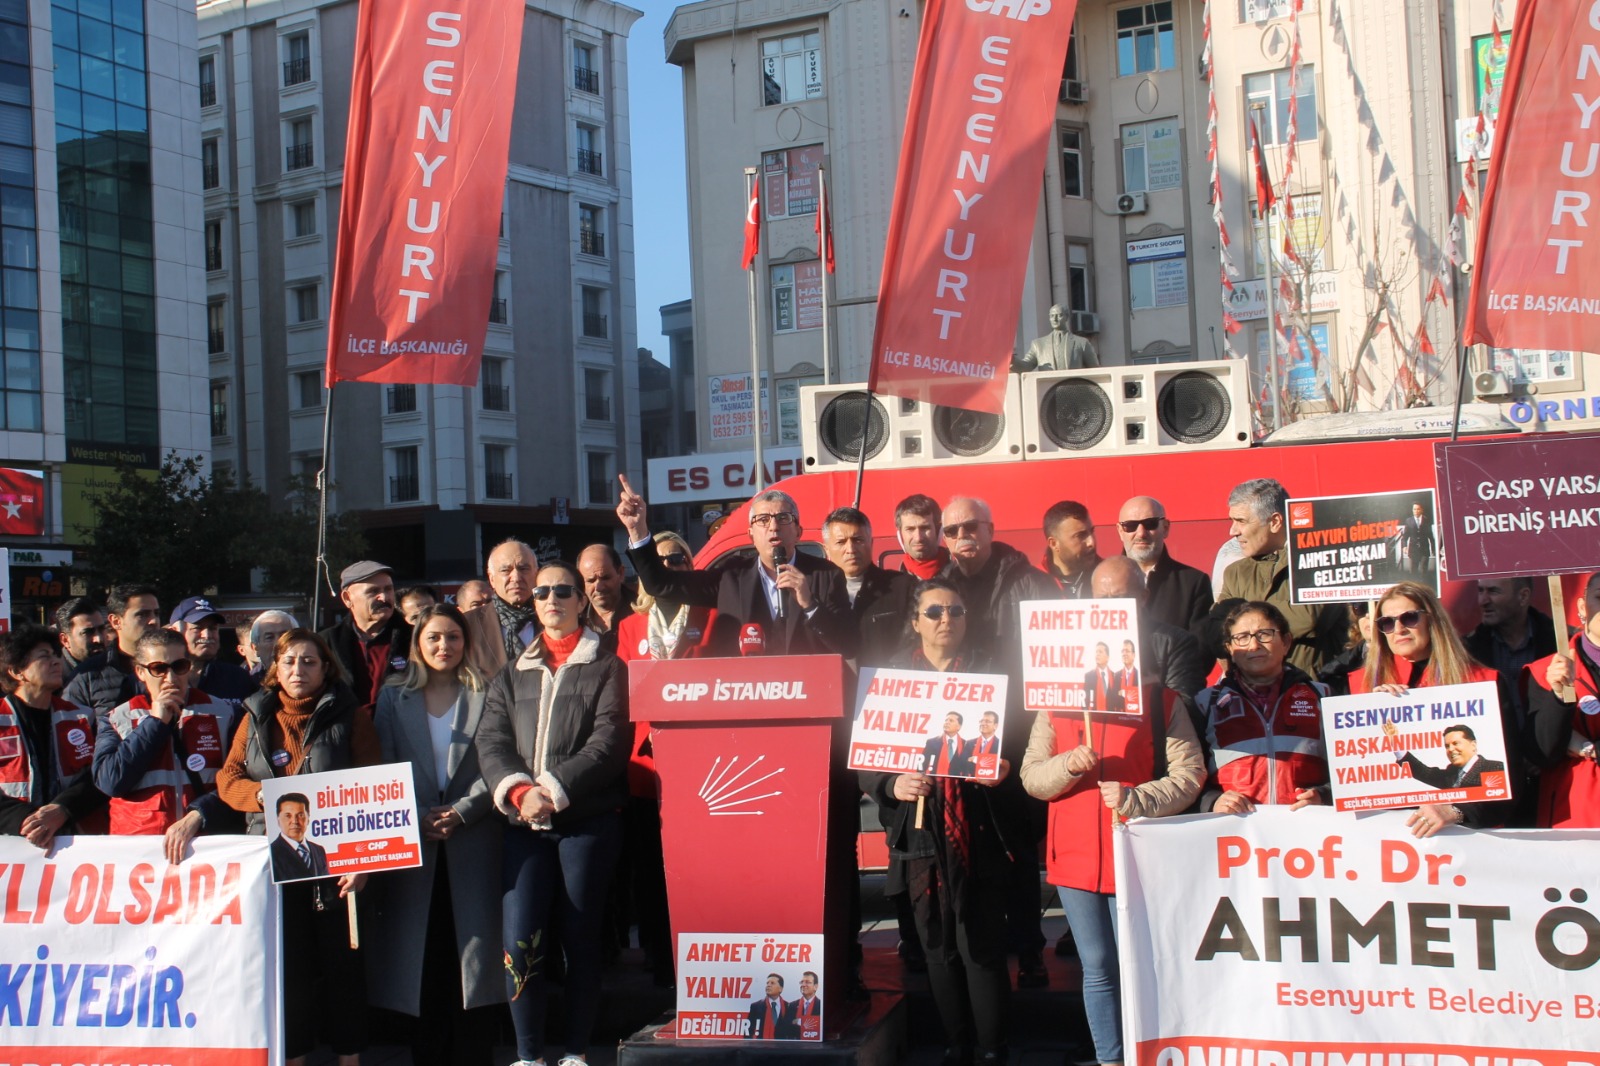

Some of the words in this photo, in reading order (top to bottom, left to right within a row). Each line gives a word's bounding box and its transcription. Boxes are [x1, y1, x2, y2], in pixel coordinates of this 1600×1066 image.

[933, 35, 1011, 340] ESENYURT
[780, 292, 788, 325] UMRE
[1488, 290, 1519, 315] İLÇE
[347, 333, 376, 358] İLÇE
[380, 337, 467, 357] BAŞKANLIĞI
[884, 347, 910, 368] İLÇE
[913, 354, 995, 380] BAŞKANLIĞI
[720, 401, 754, 413] TAŞIMACILI
[737, 390, 768, 400] PERSEL
[668, 466, 710, 492] ES
[1477, 478, 1535, 501] GASP
[1539, 474, 1600, 501] VARS
[1293, 518, 1310, 526] CHP
[1463, 506, 1545, 535] DİRENİŞ
[1297, 527, 1348, 549] KAYYUM
[1350, 519, 1399, 542] GİDECEK
[13, 552, 42, 562] PARA
[1298, 550, 1338, 570] AHMET
[1340, 543, 1387, 566] BAŞKAN
[23, 570, 62, 597] Ria
[1314, 566, 1365, 587] GELECEK
[1303, 589, 1338, 599] ESENYURT
[1340, 586, 1372, 597] BELEDİYE
[1028, 610, 1085, 630] AHMET
[1090, 604, 1128, 630] ÖZER
[1029, 645, 1085, 668] YALNIZ
[662, 683, 708, 701] CHP
[713, 679, 807, 701] İSTANBUL
[867, 677, 938, 699] AHMET
[942, 677, 995, 702] ÖZER
[1028, 684, 1086, 707] DEĞİLDİR
[863, 709, 931, 734] YALNIZ
[1334, 705, 1425, 729] ESENYURT
[1431, 699, 1485, 720] HALKI
[1335, 731, 1443, 759] BAŞKANININ
[853, 746, 925, 770] DEĞİLDİR
[1335, 761, 1413, 785] YANINDA
[317, 782, 369, 809] BİLİMİN
[373, 779, 404, 805] IŞIĞI
[1343, 798, 1372, 810] SEÇİLMİŞ
[1373, 795, 1405, 807] ESENYURT
[1407, 792, 1438, 804] BELEDİYE
[1439, 791, 1467, 801] BAŞKANI
[1486, 788, 1504, 797] CHP
[312, 812, 343, 837] GERİ
[347, 809, 411, 833] DÖNECEK
[368, 840, 388, 851] CHP
[329, 858, 358, 868] ESENYURT
[360, 854, 387, 865] BELEDİYE
[388, 851, 413, 863] BAŞKANI
[1217, 835, 1358, 882] Prof.
[1381, 839, 1467, 887] Dr.
[0, 863, 56, 925] LI
[64, 862, 242, 925] OLSADA
[1195, 896, 1510, 971] AHMET
[686, 943, 756, 962] AHMET
[761, 938, 812, 962] ÖZER
[685, 977, 753, 998] YALNIZ
[1276, 982, 1415, 1015] Esenyurt
[1429, 987, 1563, 1022] Belediye
[1574, 994, 1600, 1019] B
[681, 1013, 750, 1036] DEĞİLDİR
